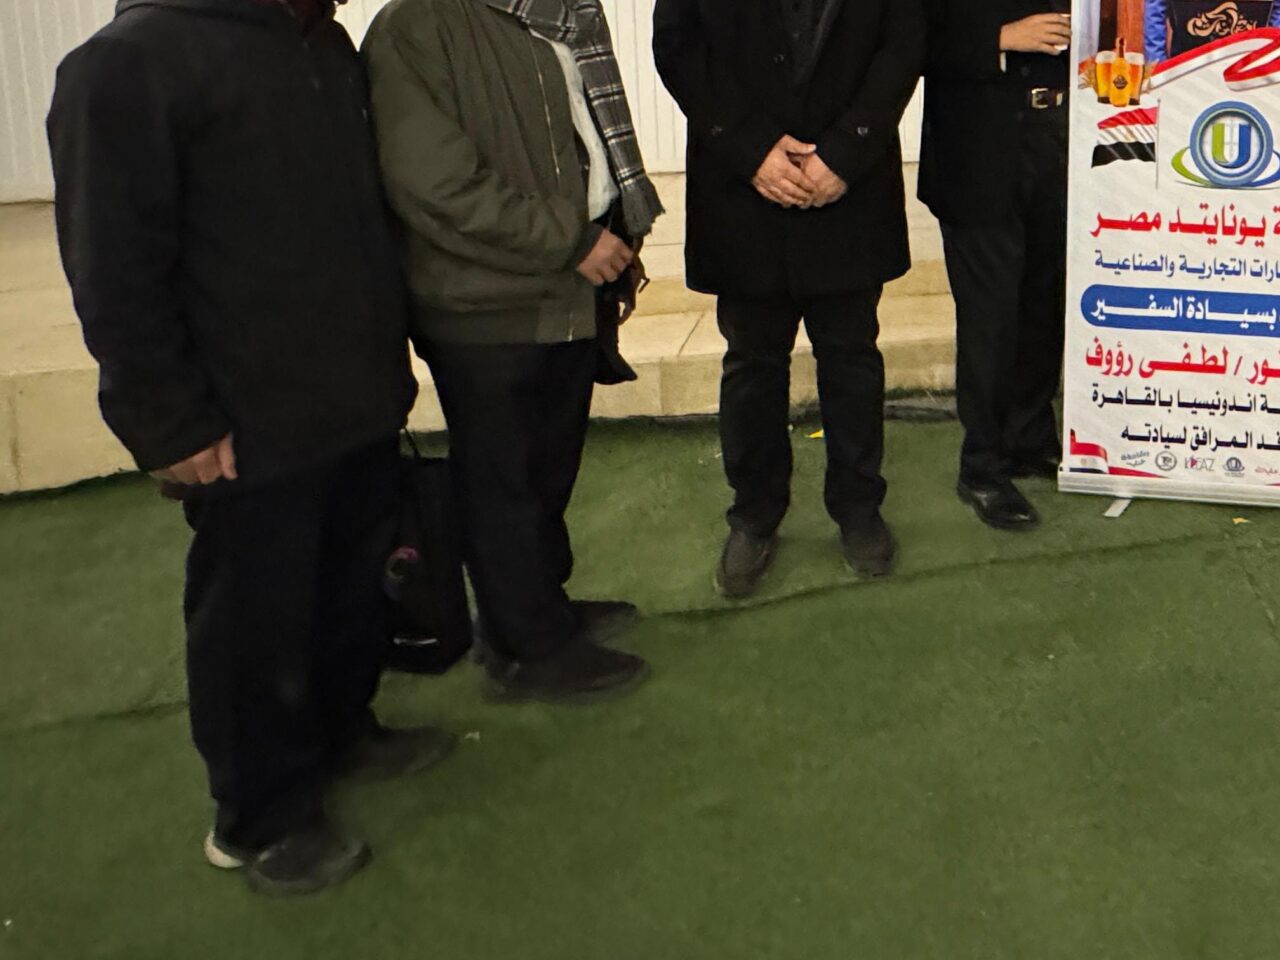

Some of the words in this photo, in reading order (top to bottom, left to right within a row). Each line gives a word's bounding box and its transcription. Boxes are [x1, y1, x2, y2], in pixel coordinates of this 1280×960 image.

[1211, 122, 1253, 166] U
[1089, 208, 1161, 237] مصر
[1169, 203, 1266, 247] يونايتد
[1095, 249, 1175, 277] والصناعية
[1179, 254, 1246, 281] التجارية
[1091, 293, 1183, 321] السفير
[1186, 297, 1276, 330] بسيادة
[1092, 383, 1173, 413] بالقاهرة
[1121, 423, 1187, 449] لسيادته
[1190, 426, 1252, 451] المرافق
